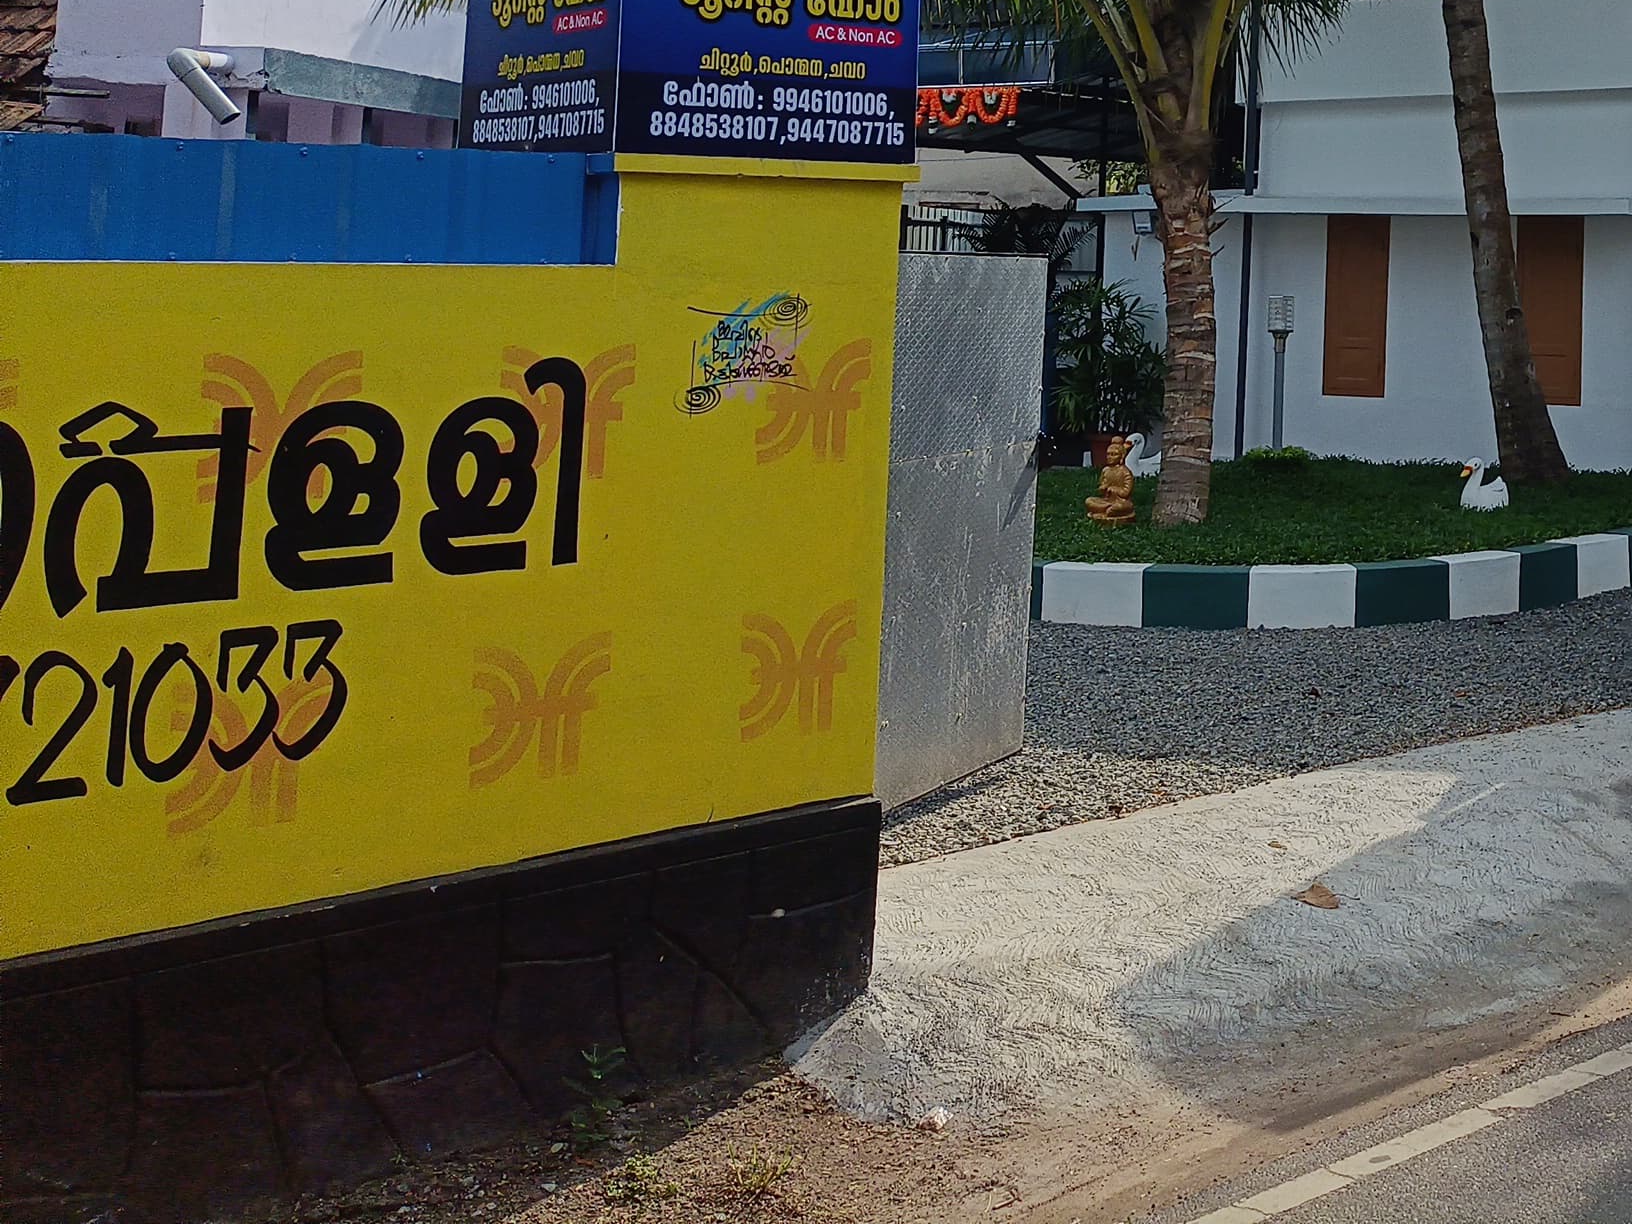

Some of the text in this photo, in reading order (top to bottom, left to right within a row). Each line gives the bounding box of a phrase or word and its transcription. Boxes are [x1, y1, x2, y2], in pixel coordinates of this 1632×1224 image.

[557, 10, 604, 32] AC & Non AC
[815, 27, 896, 45] AC & Non AC
[532, 79, 600, 111] 9946101006,
[773, 87, 895, 122] 9946101006,
[0, 618, 349, 808] 21033
